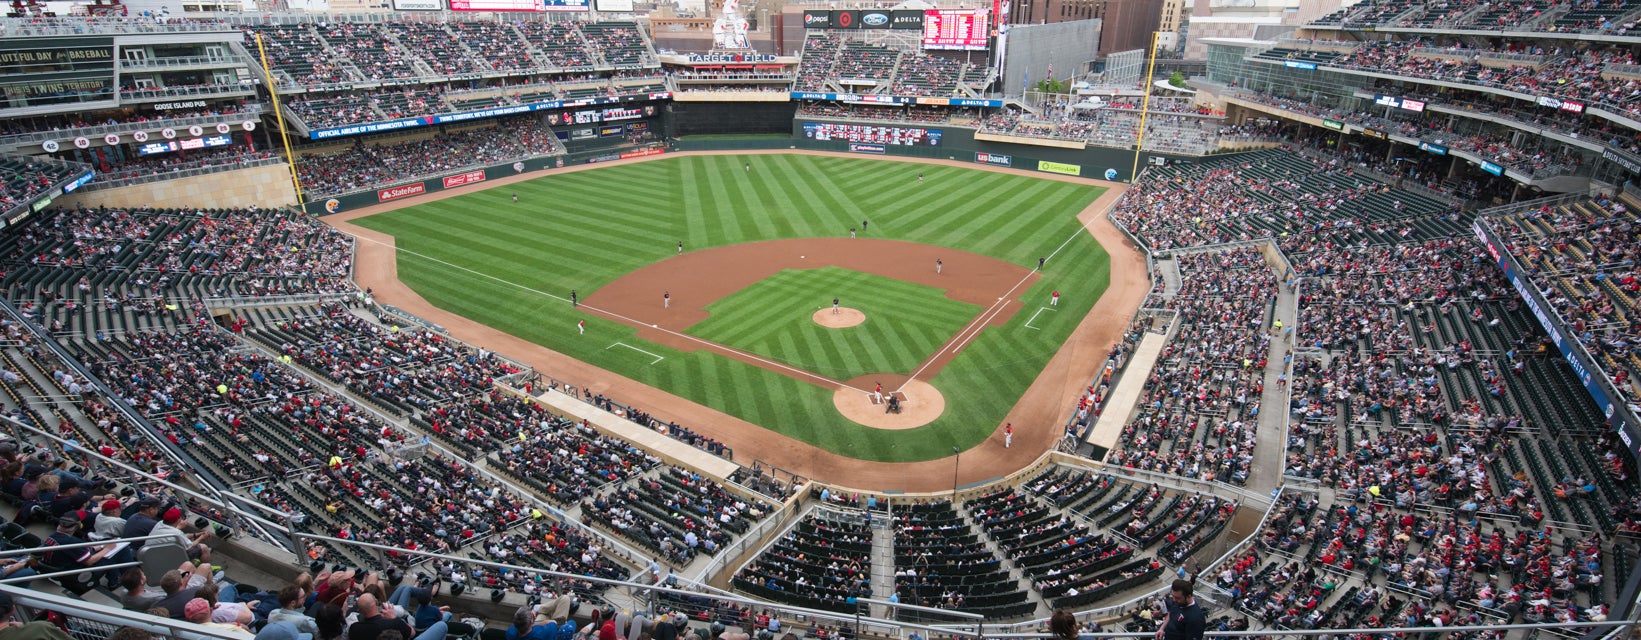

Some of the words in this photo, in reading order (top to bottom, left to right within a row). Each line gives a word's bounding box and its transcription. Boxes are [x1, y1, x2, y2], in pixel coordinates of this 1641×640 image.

[36, 52, 52, 60] DAY
[69, 50, 111, 59] BASEBALL
[3, 86, 20, 95] THIS
[32, 83, 64, 94] TWINS
[67, 80, 104, 90] TERRITORY
[318, 129, 340, 138] OFFICIAL
[341, 126, 360, 135] AIRLINE
[377, 122, 403, 130] MINNESOTA
[1606, 151, 1618, 162] DELTA
[1630, 163, 1641, 174] CLUB
[1571, 356, 1585, 378] DELTA
